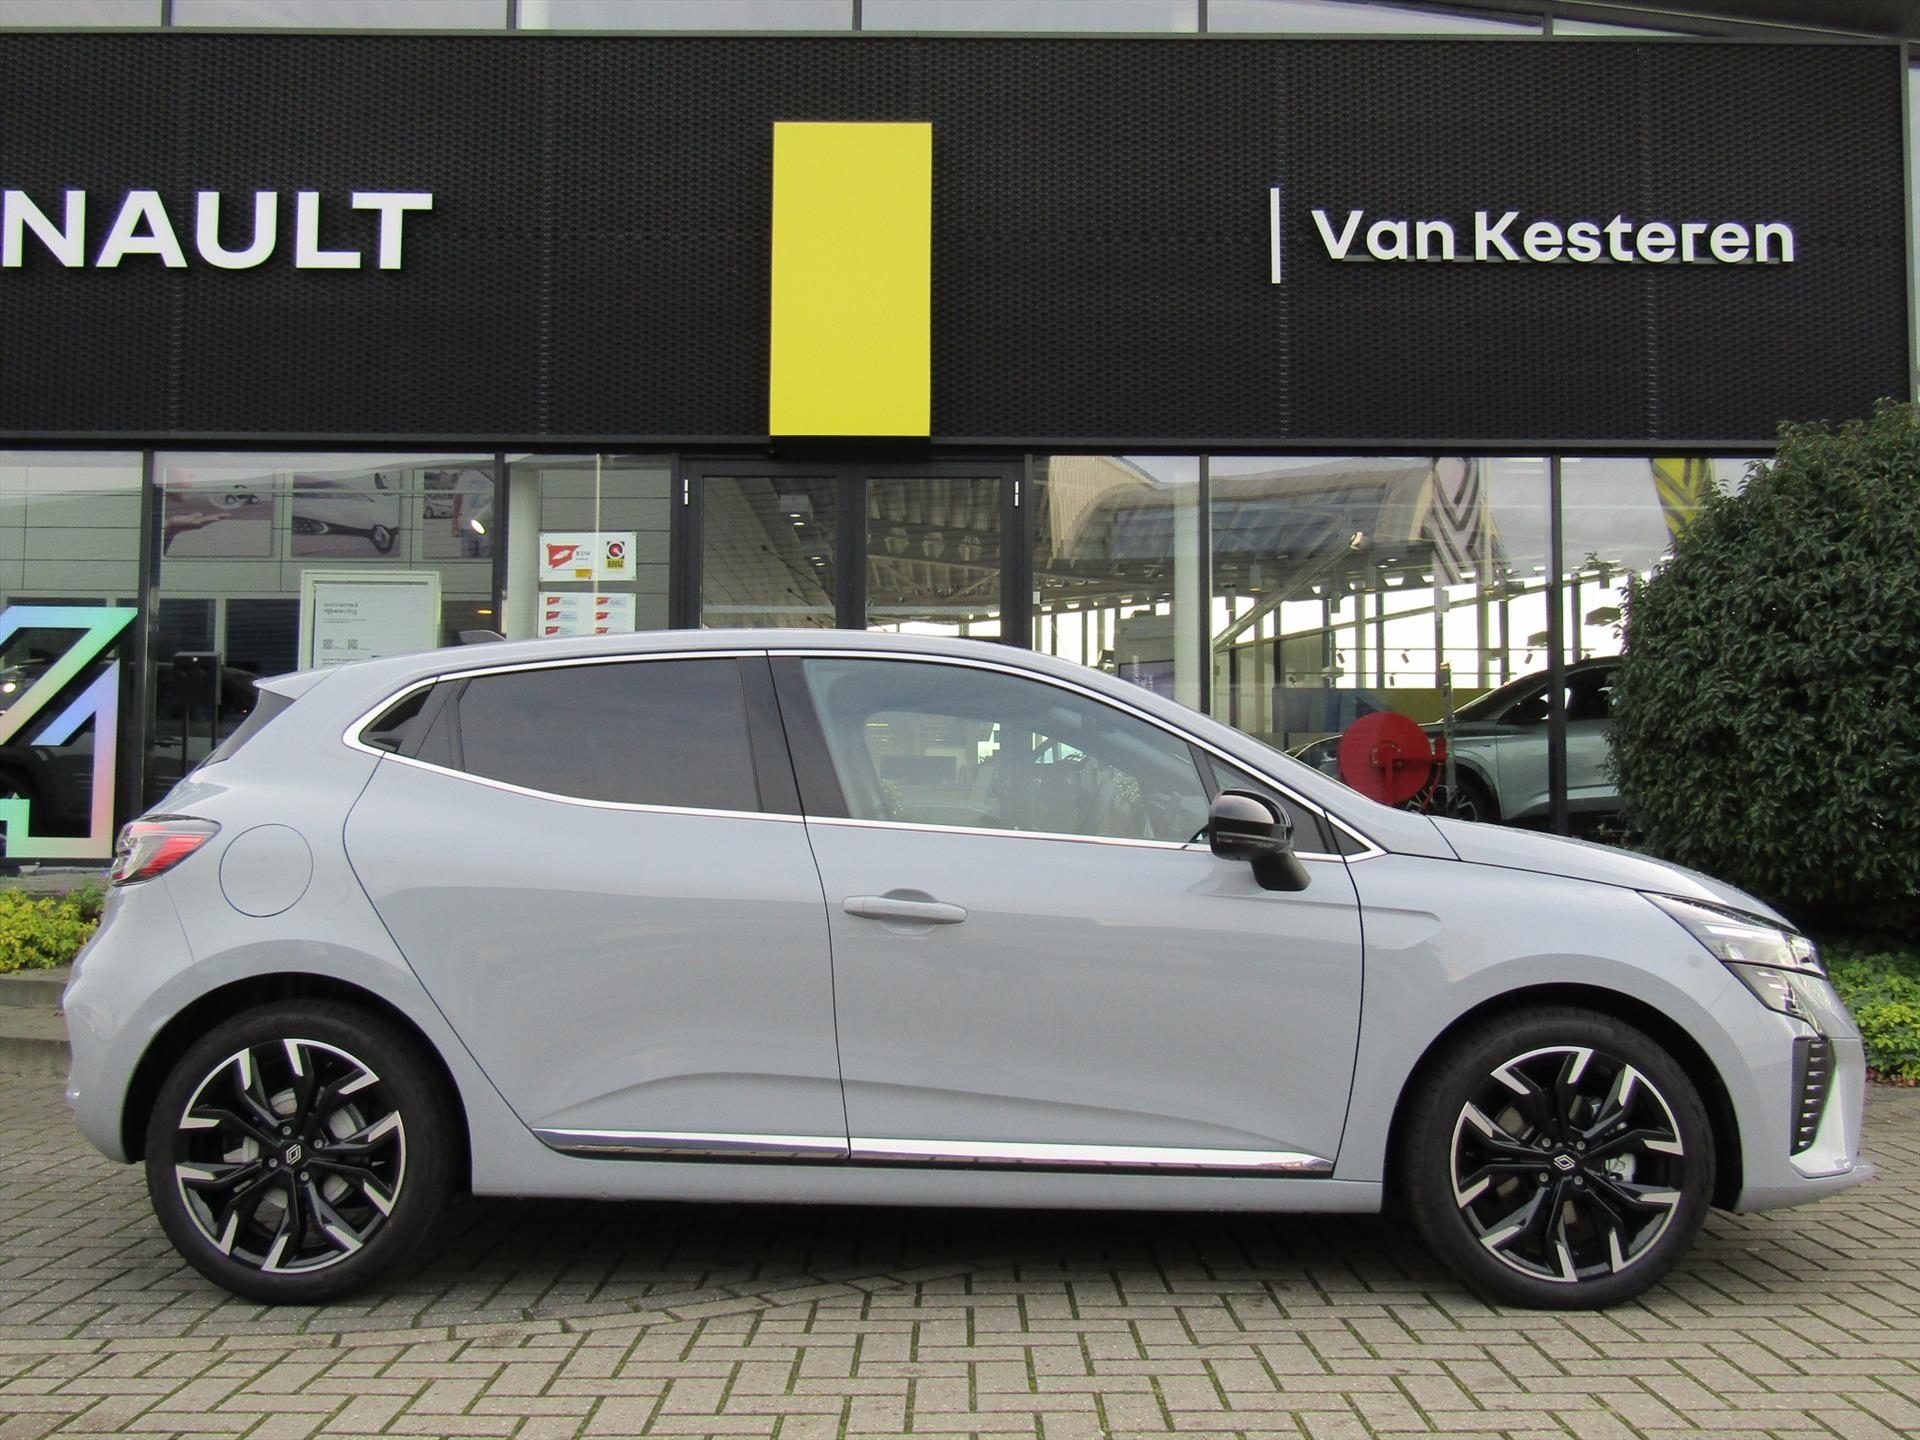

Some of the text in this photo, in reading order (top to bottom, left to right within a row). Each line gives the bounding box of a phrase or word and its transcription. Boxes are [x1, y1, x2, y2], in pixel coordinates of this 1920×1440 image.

[2, 189, 433, 270] NAULT
[1311, 209, 1795, 263] Van Kesteren
